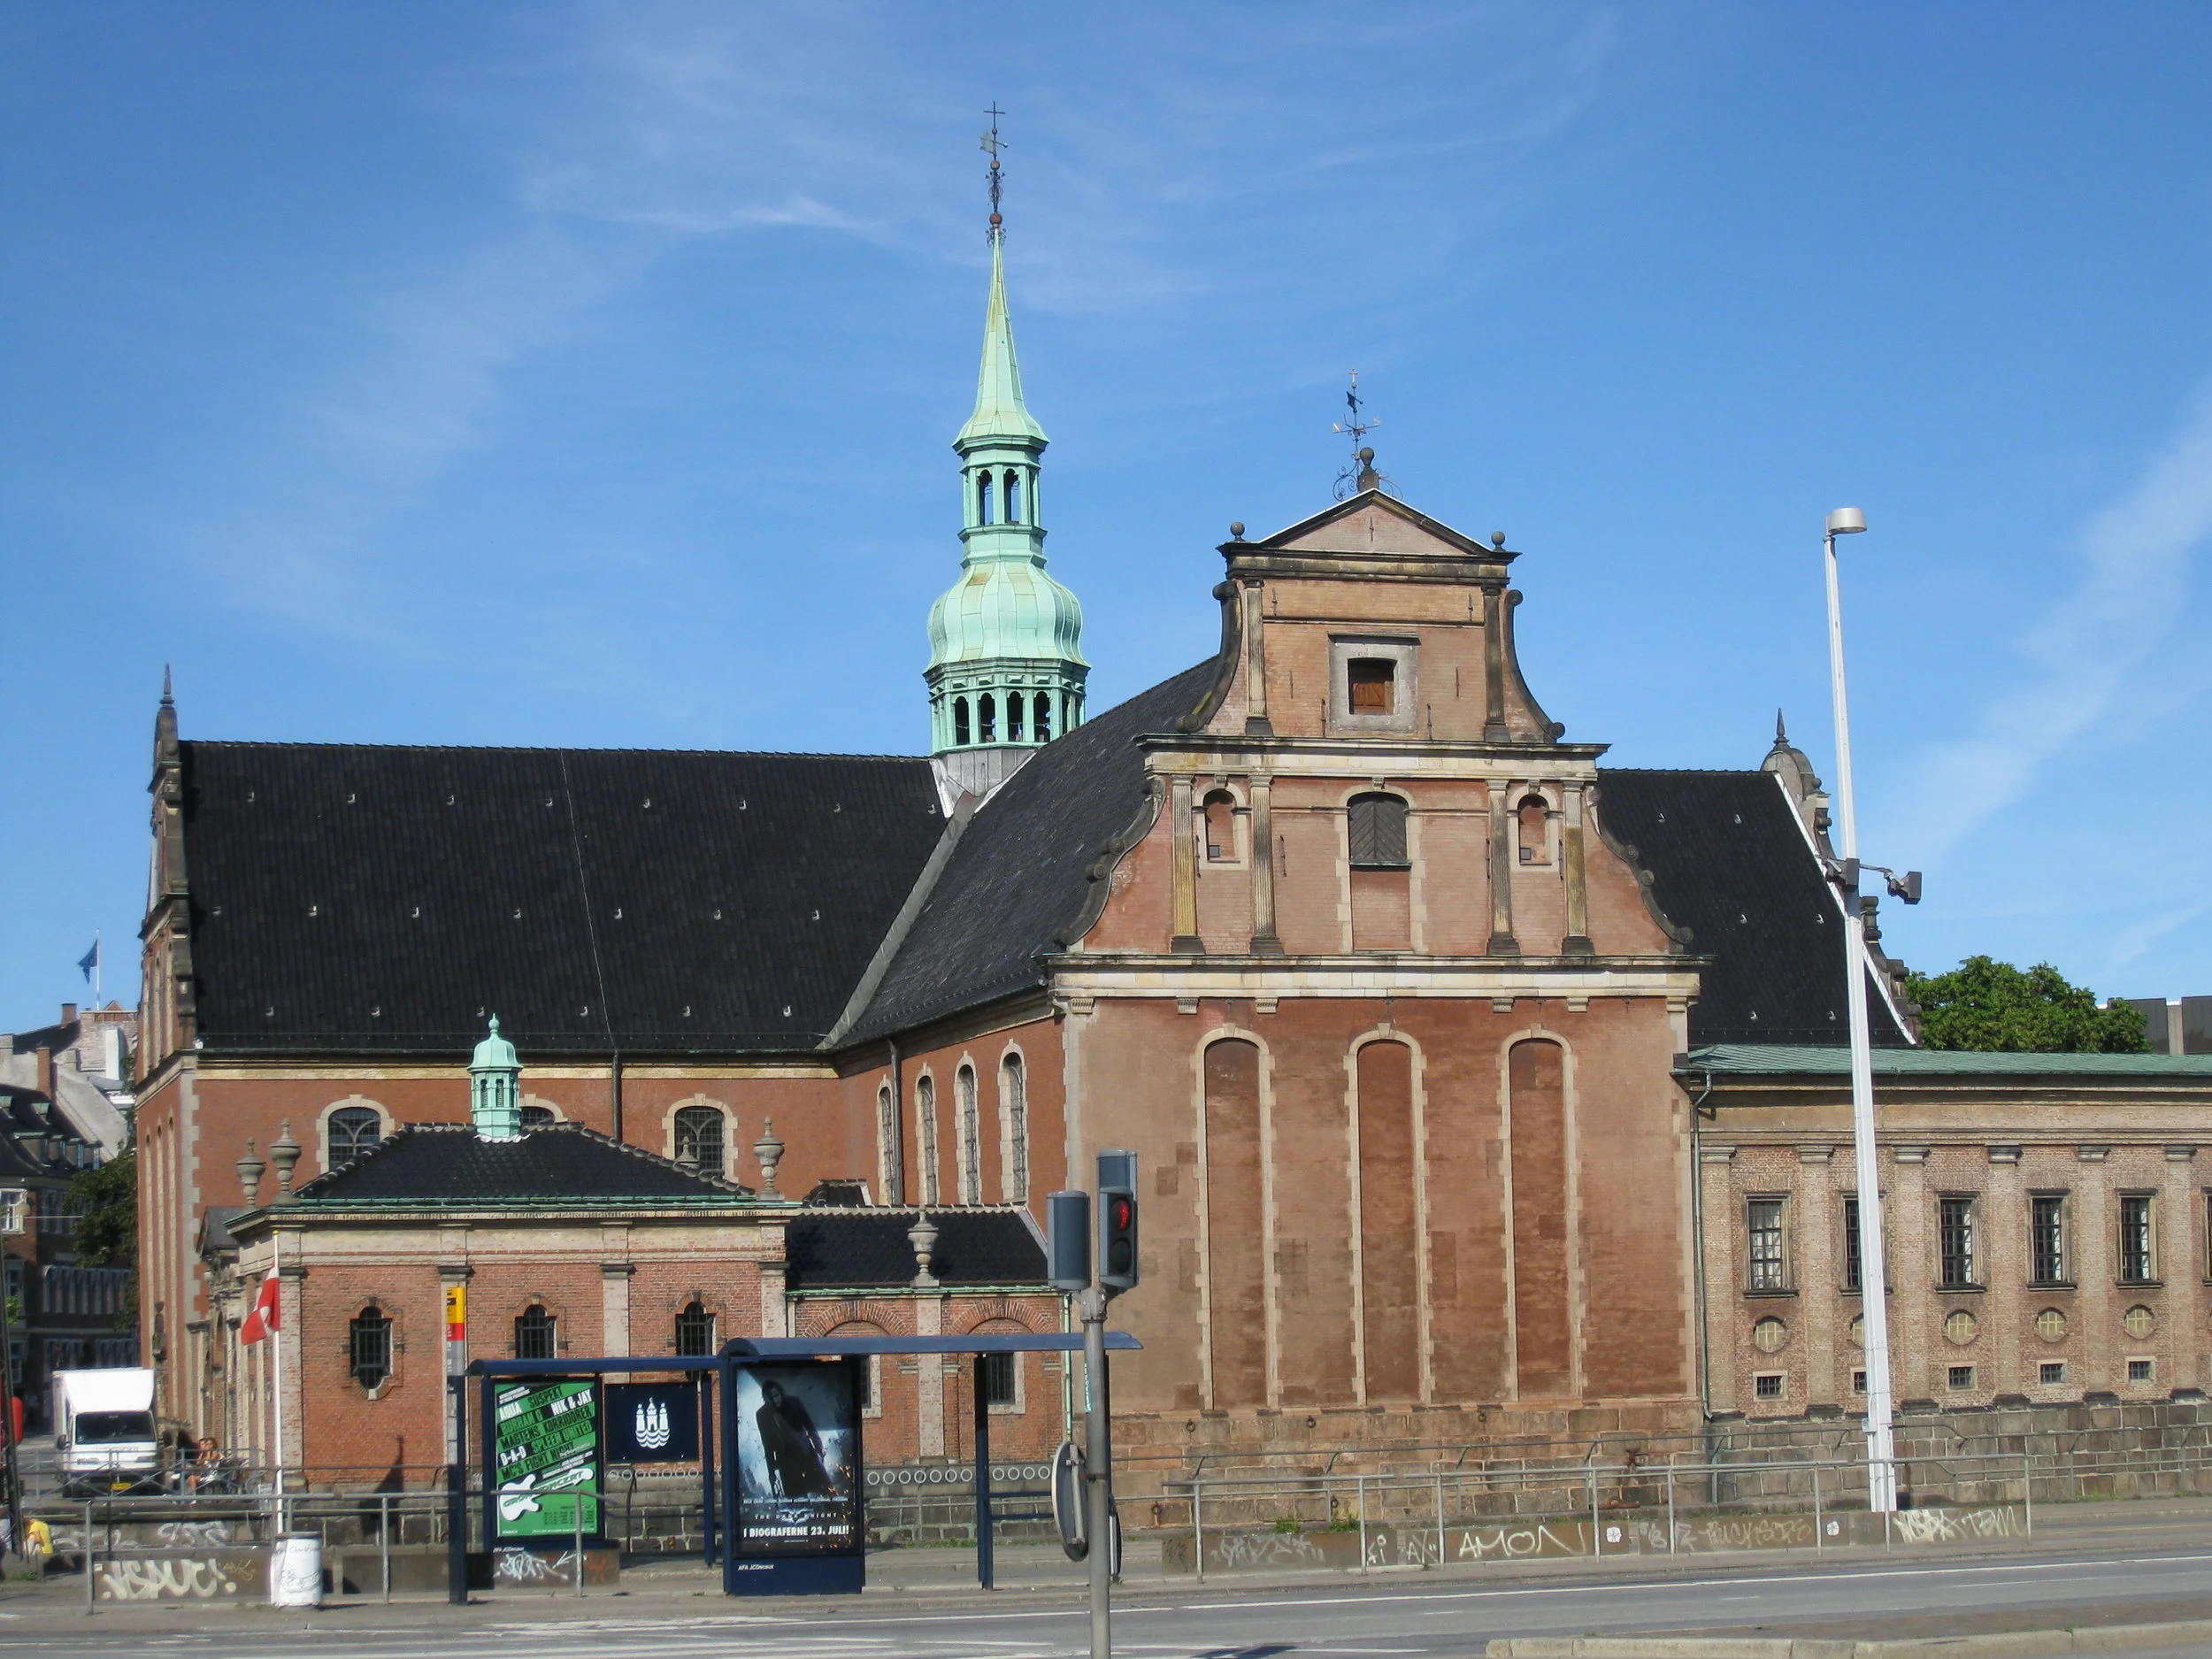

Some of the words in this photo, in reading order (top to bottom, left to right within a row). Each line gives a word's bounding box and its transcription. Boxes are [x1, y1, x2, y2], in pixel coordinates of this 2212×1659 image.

[528, 1386, 564, 1409] SUSPEKT
[550, 1400, 569, 1416] NIK
[567, 1396, 577, 1409] &
[577, 1389, 592, 1406] JAY
[499, 1402, 523, 1421] AQUA
[500, 1425, 541, 1450] MAGTENS
[500, 1446, 526, 1466] D-A-D
[501, 1463, 524, 1481] MC'S
[525, 1452, 549, 1471] FIGHT
[743, 1527, 748, 1538] I
[749, 1525, 808, 1538] BIOGRAFERNE
[810, 1525, 826, 1536] 23.
[828, 1525, 849, 1536] JULI!
